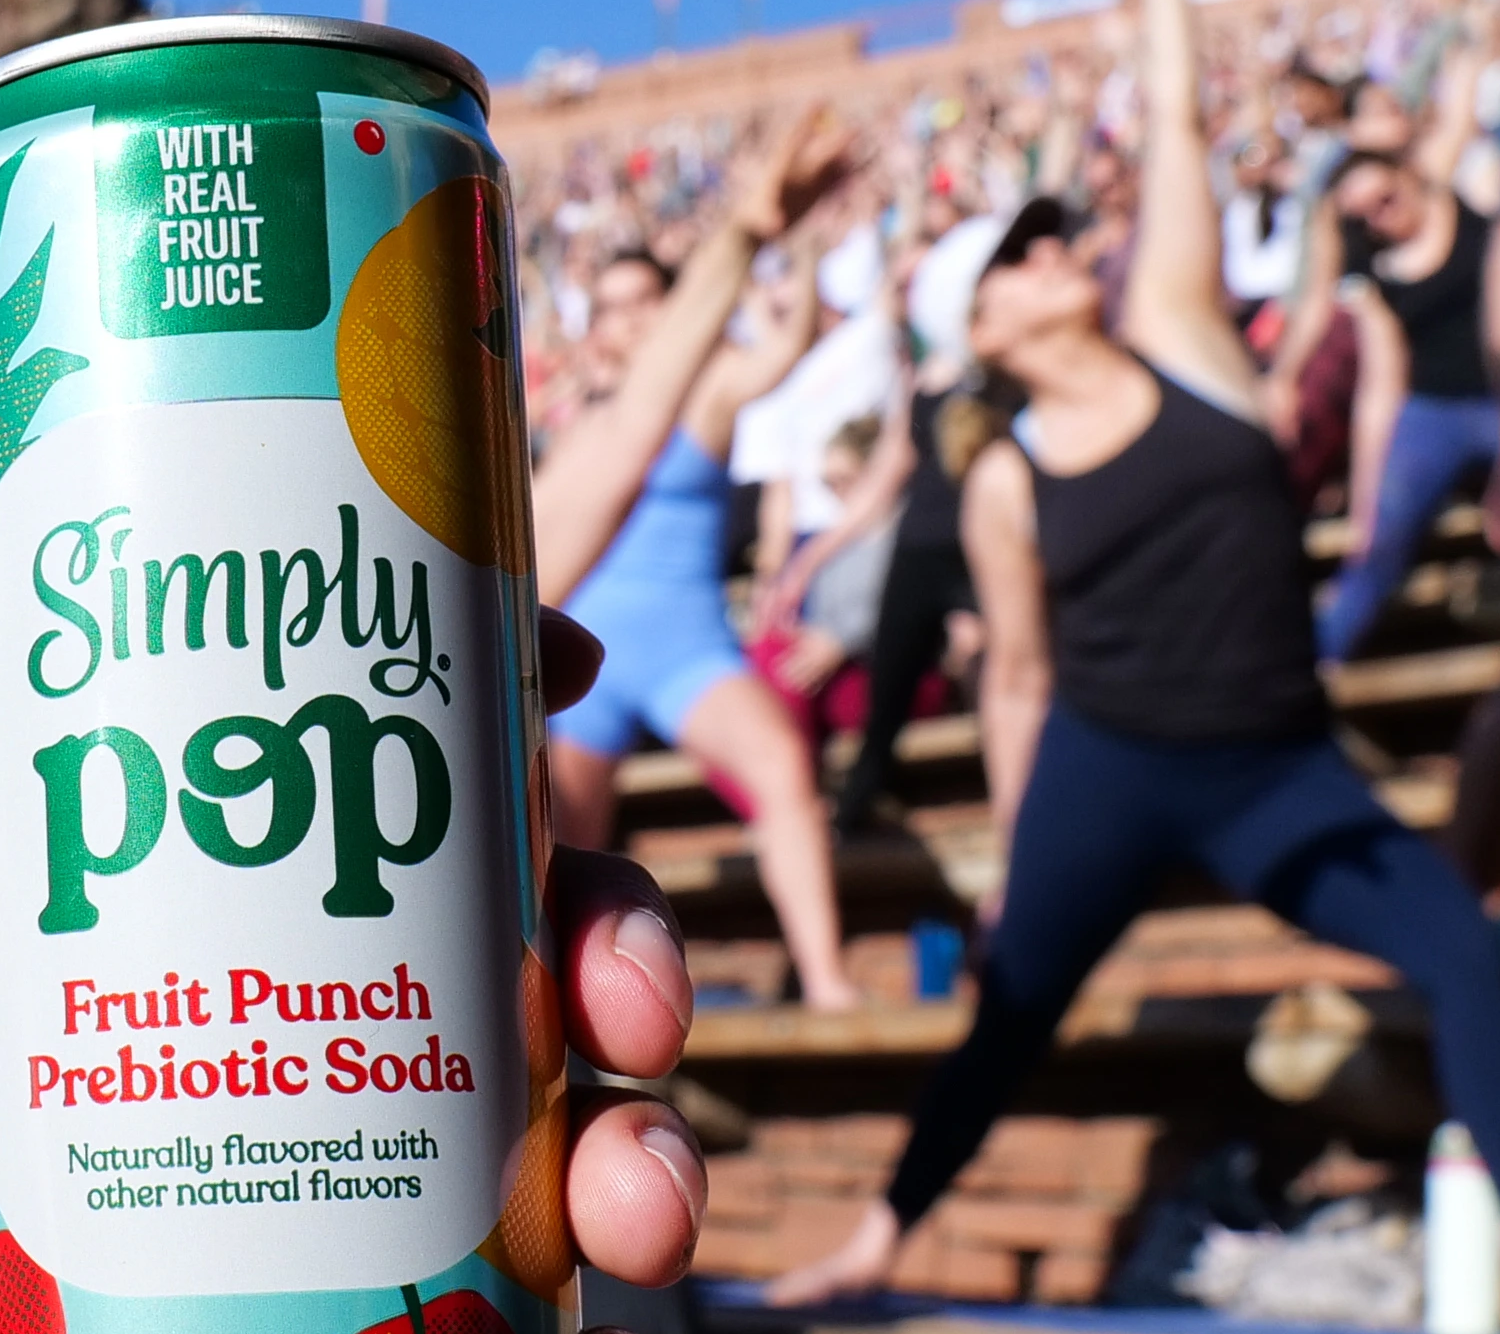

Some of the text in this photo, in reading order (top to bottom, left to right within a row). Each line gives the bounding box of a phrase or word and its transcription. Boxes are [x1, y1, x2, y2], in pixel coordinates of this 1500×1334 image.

[157, 123, 254, 170] WITH
[164, 171, 257, 216] REAL
[158, 216, 265, 262] FRUIT
[160, 262, 264, 311] JUICE
[32, 694, 452, 935] pop
[62, 962, 432, 1035] Fruit Punch
[28, 1034, 475, 1109] Prebiotic Soda
[67, 1128, 439, 1175] Naturally flavored with
[87, 1169, 423, 1211] other natural flavors
